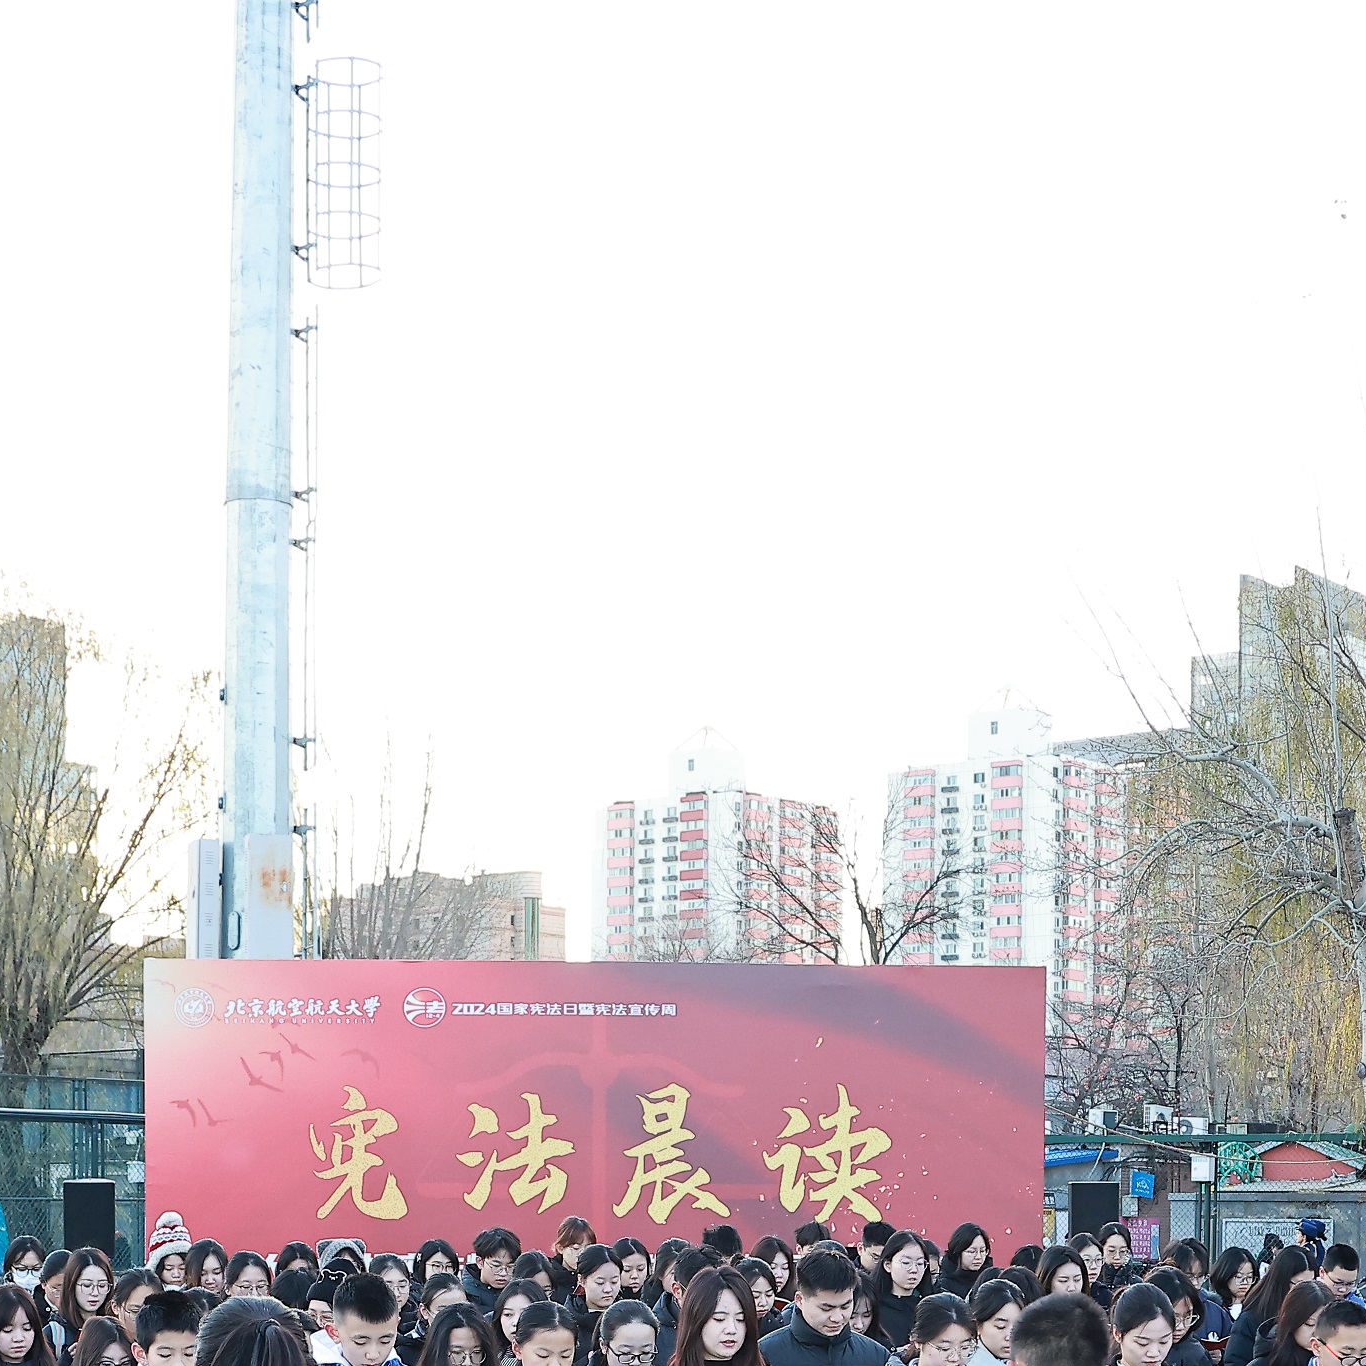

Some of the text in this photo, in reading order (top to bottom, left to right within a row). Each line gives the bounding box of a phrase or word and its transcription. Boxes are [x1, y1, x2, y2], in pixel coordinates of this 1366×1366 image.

[223, 994, 382, 1019] 北京航空航天大學
[451, 1001, 678, 1017] 2024国家宪法日暨宪法宣传周
[224, 1017, 376, 1025] BEIHANG UNIVERSITY
[309, 1083, 893, 1224] 宪法晨读
